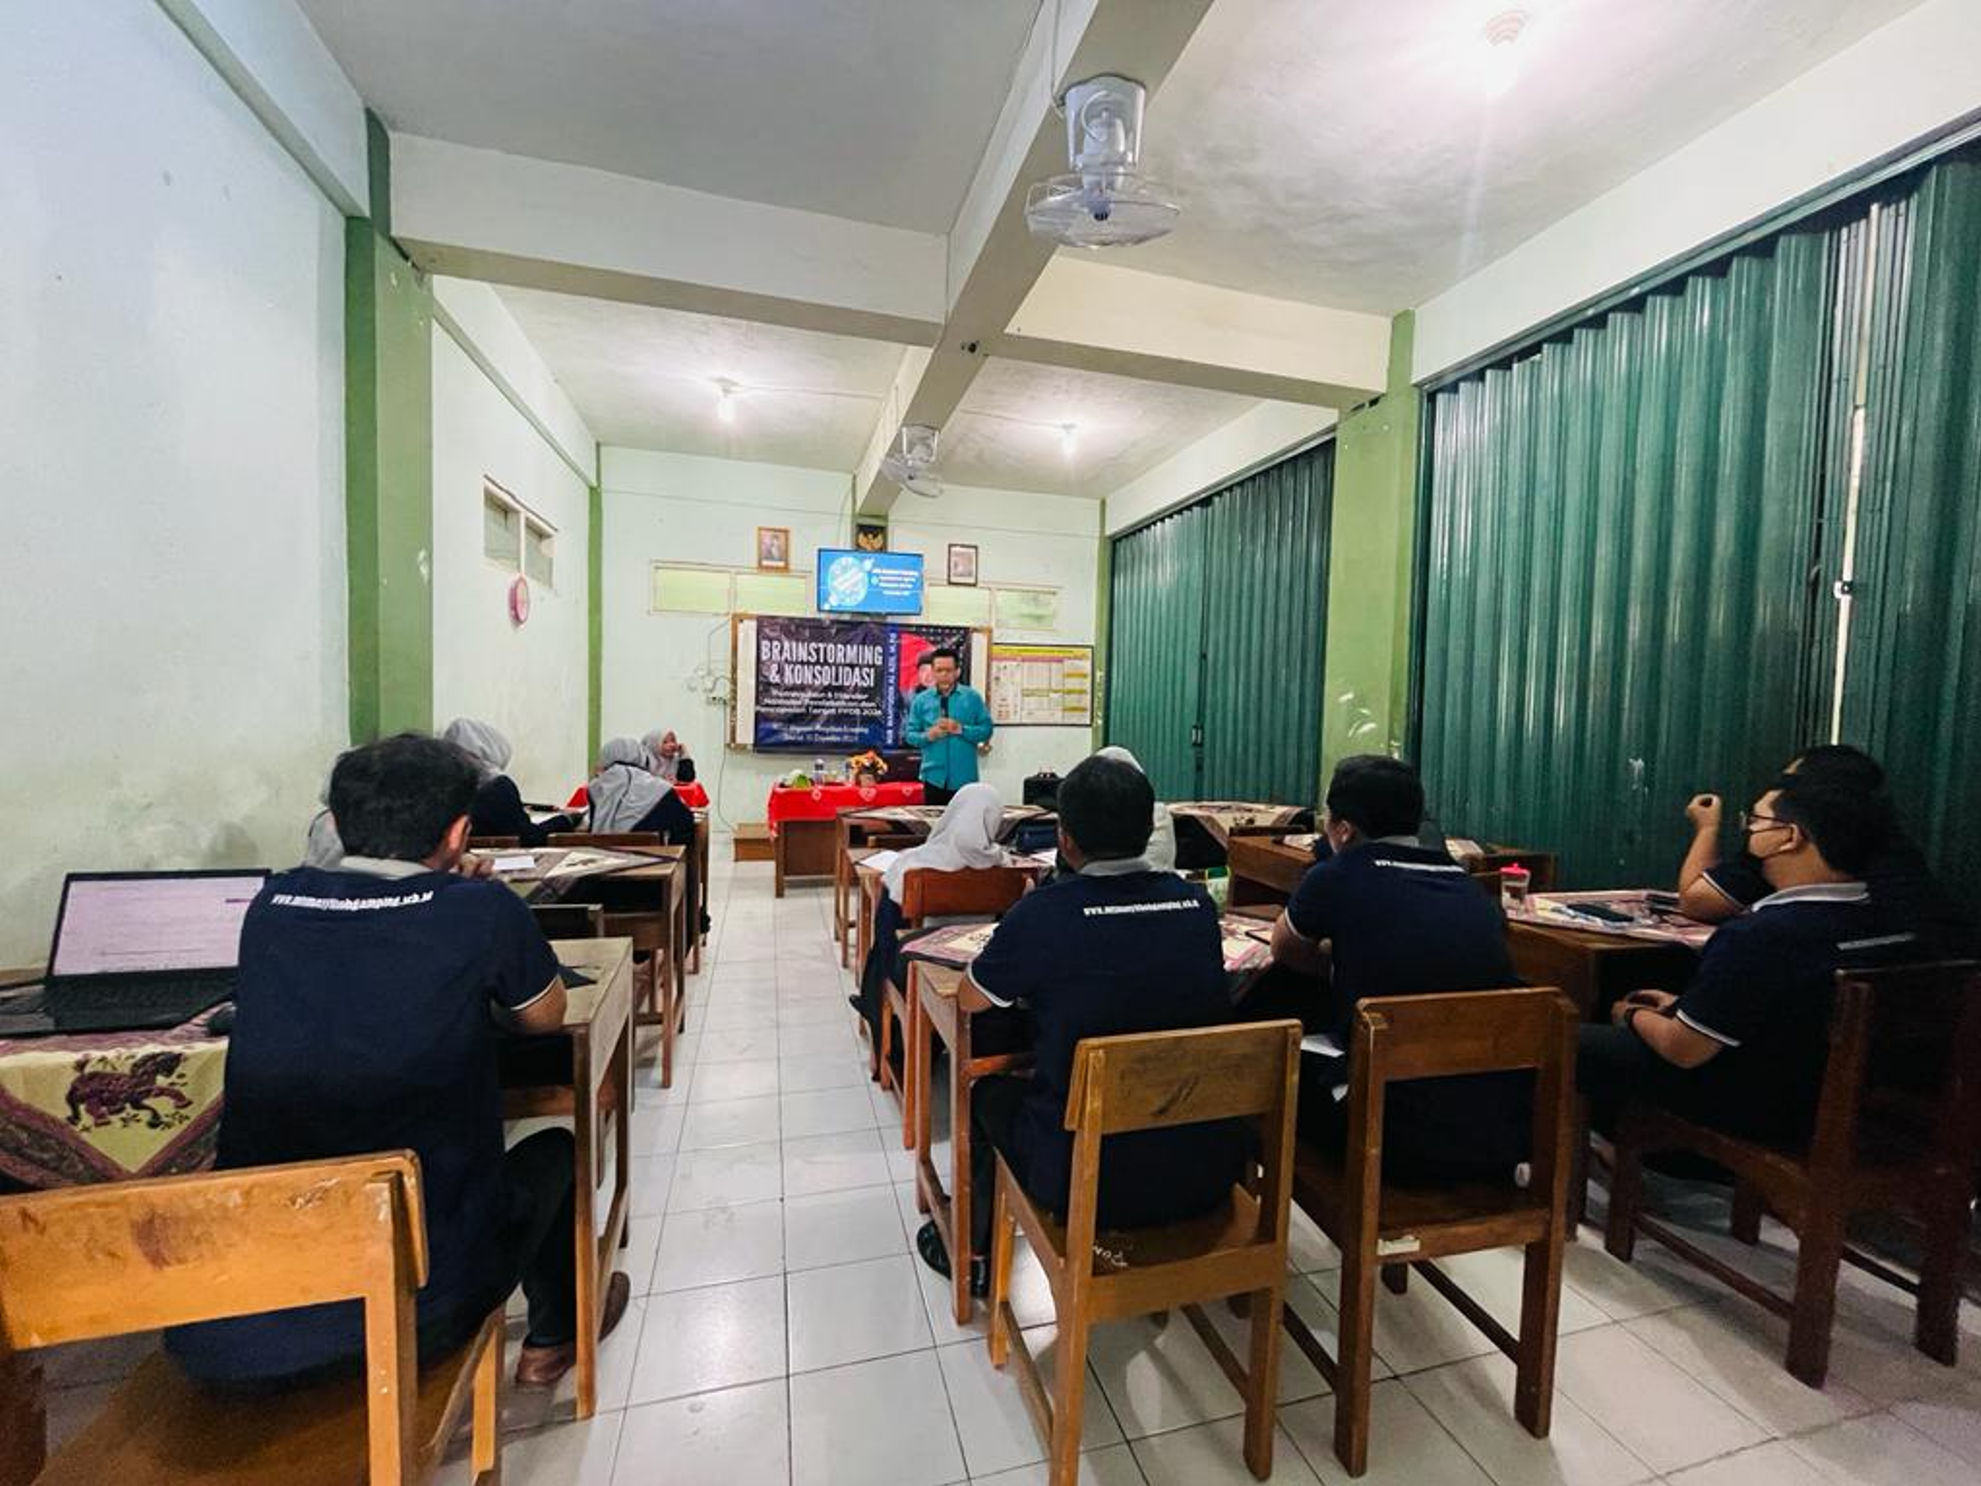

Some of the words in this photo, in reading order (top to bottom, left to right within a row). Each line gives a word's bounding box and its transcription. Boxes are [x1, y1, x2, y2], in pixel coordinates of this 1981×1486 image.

[761, 640, 883, 665] BRAINSTORMING
[770, 663, 780, 683] &
[784, 664, 875, 687] KONSOLIDASI
